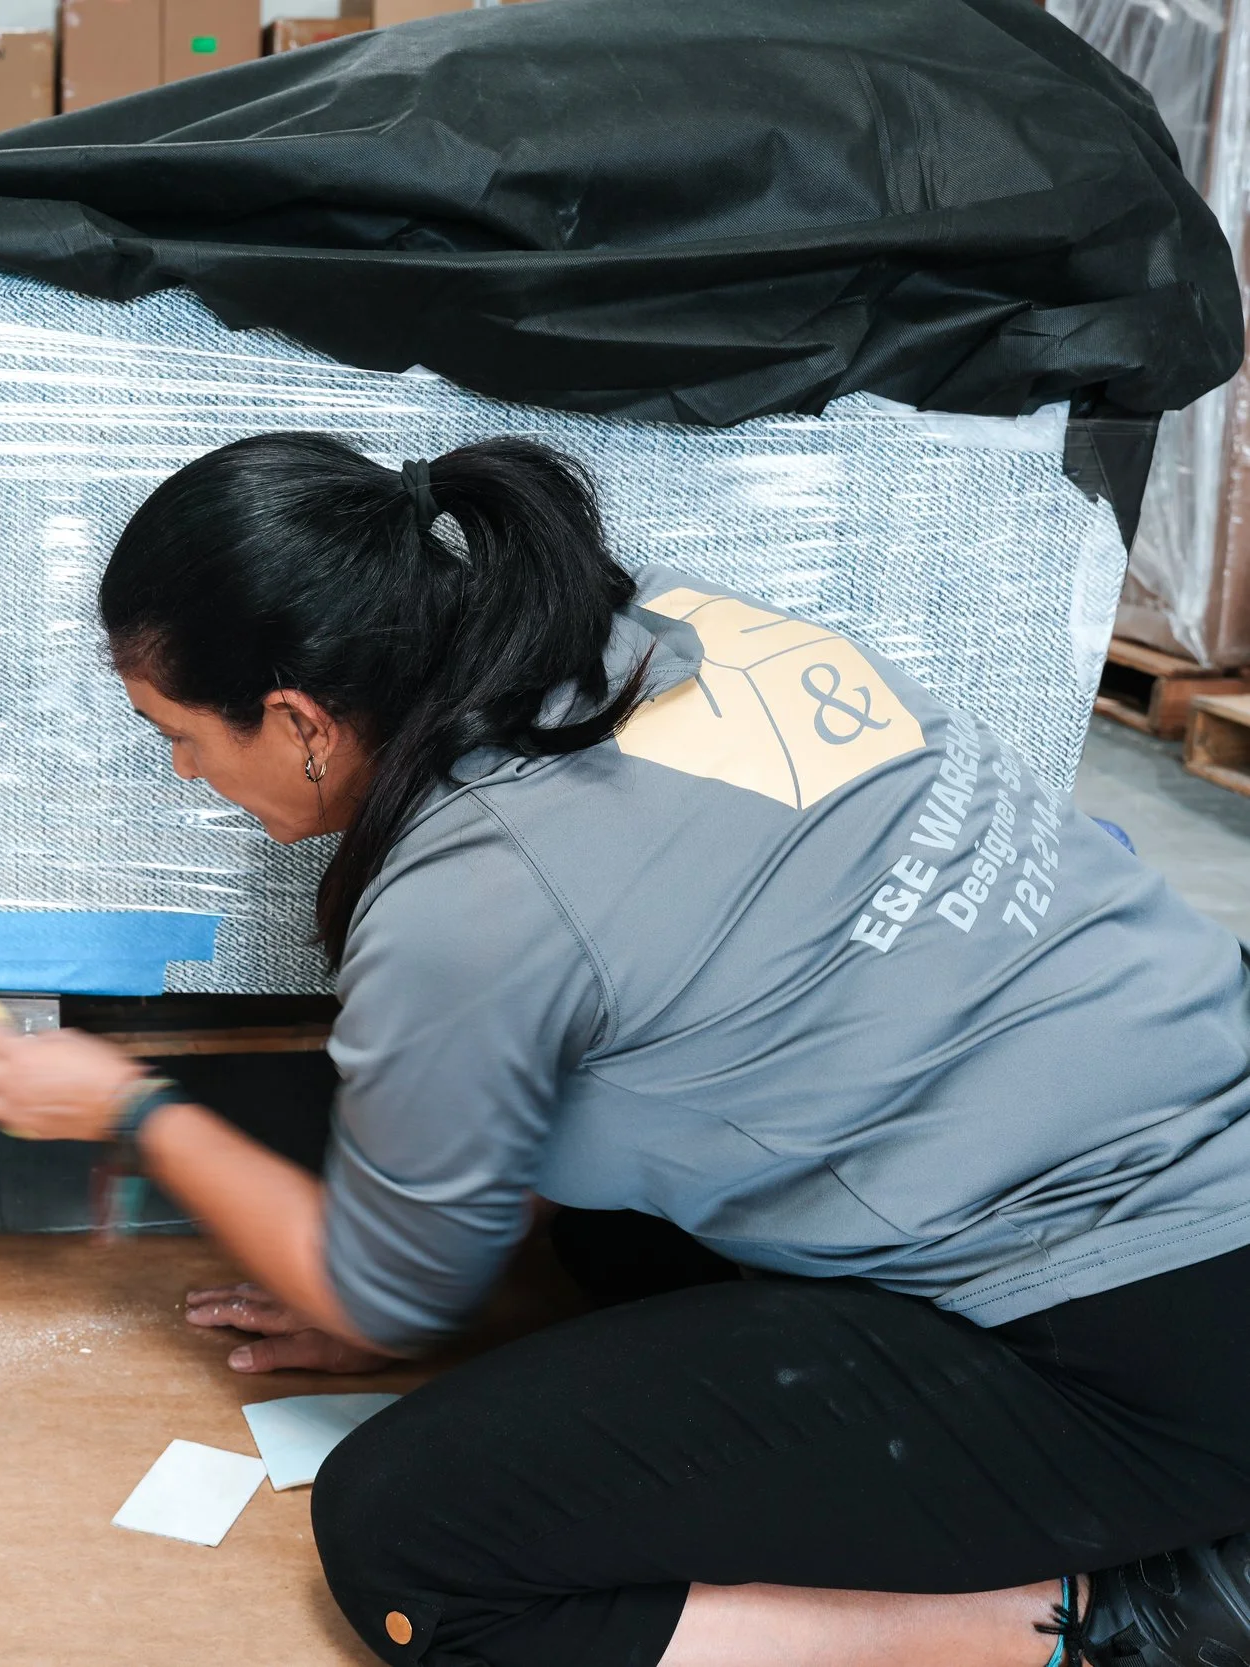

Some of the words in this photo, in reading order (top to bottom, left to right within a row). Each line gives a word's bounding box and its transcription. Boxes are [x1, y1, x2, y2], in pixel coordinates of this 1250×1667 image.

[801, 663, 891, 745] &
[850, 855, 939, 953] E&E
[936, 789, 1018, 934] Designer
[1002, 777, 1063, 938] 727-214-4
